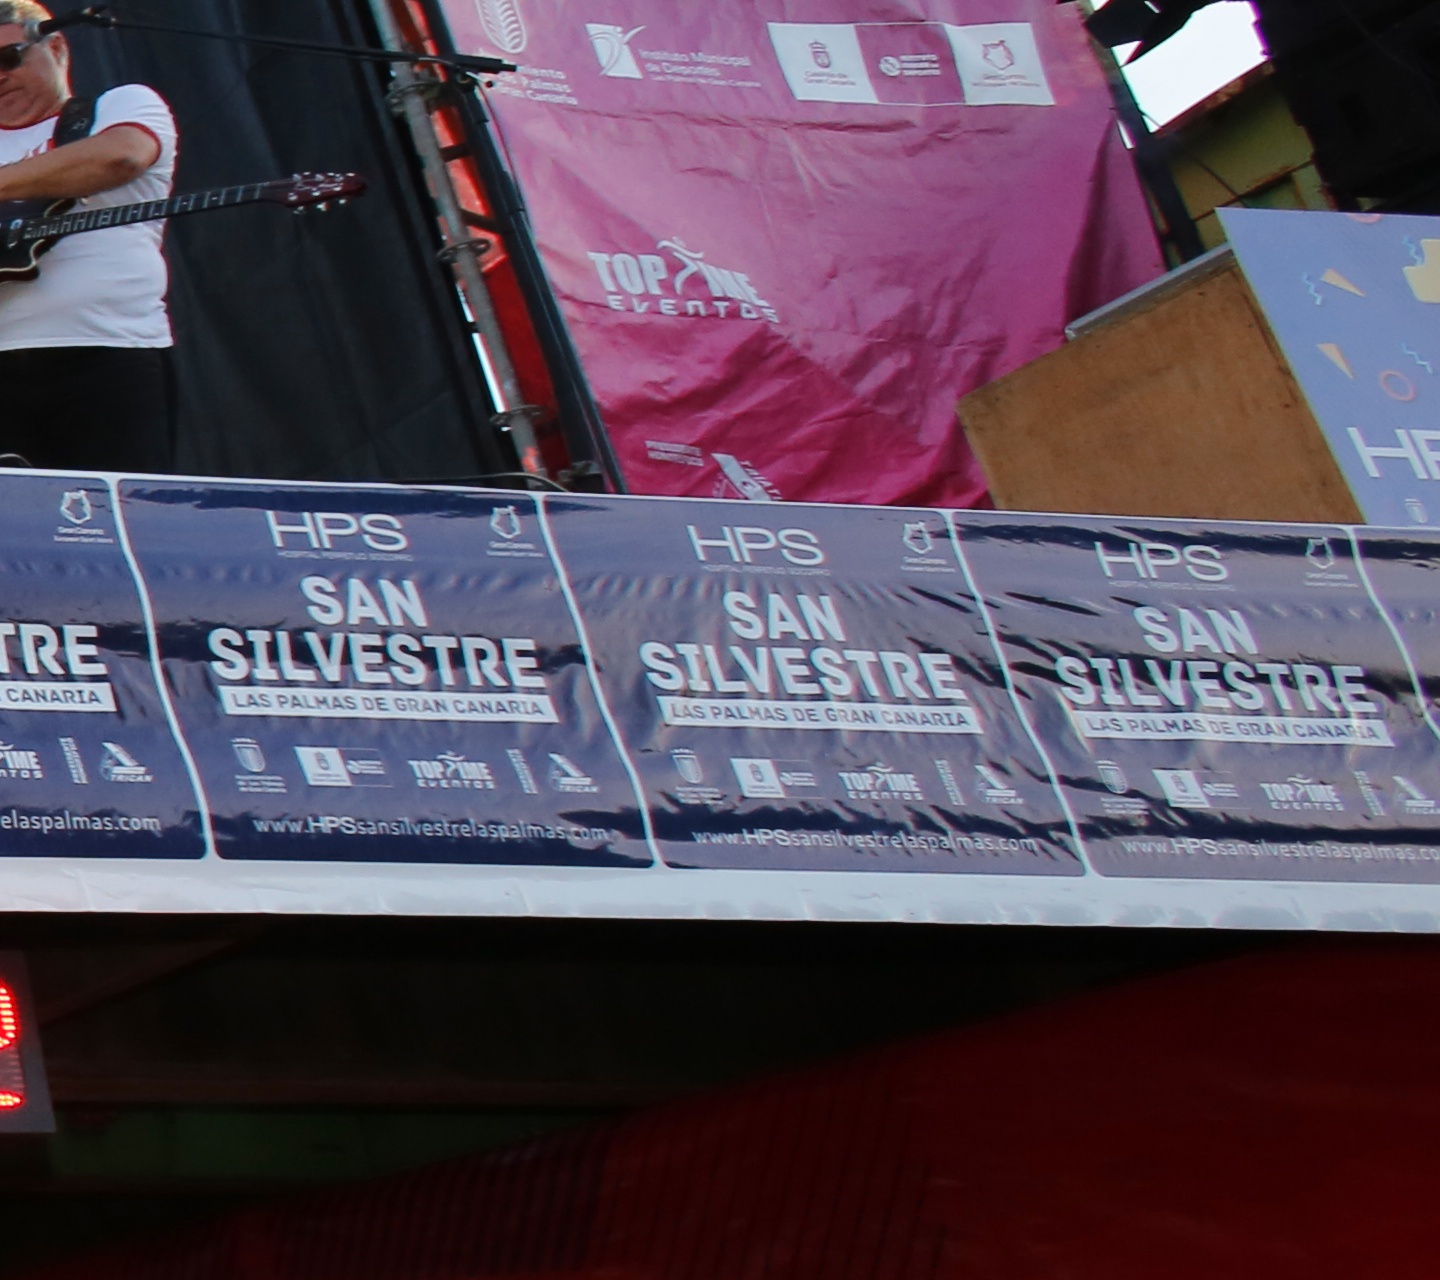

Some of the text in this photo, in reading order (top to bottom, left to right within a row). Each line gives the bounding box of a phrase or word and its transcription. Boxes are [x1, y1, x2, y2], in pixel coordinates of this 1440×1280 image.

[266, 510, 409, 551] HPS
[1094, 541, 1229, 582] HPS
[300, 576, 428, 627] SAN
[1133, 605, 1259, 656] SAN
[208, 628, 547, 689] SILVESTRE
[1053, 656, 1379, 714] SILVESTRE
